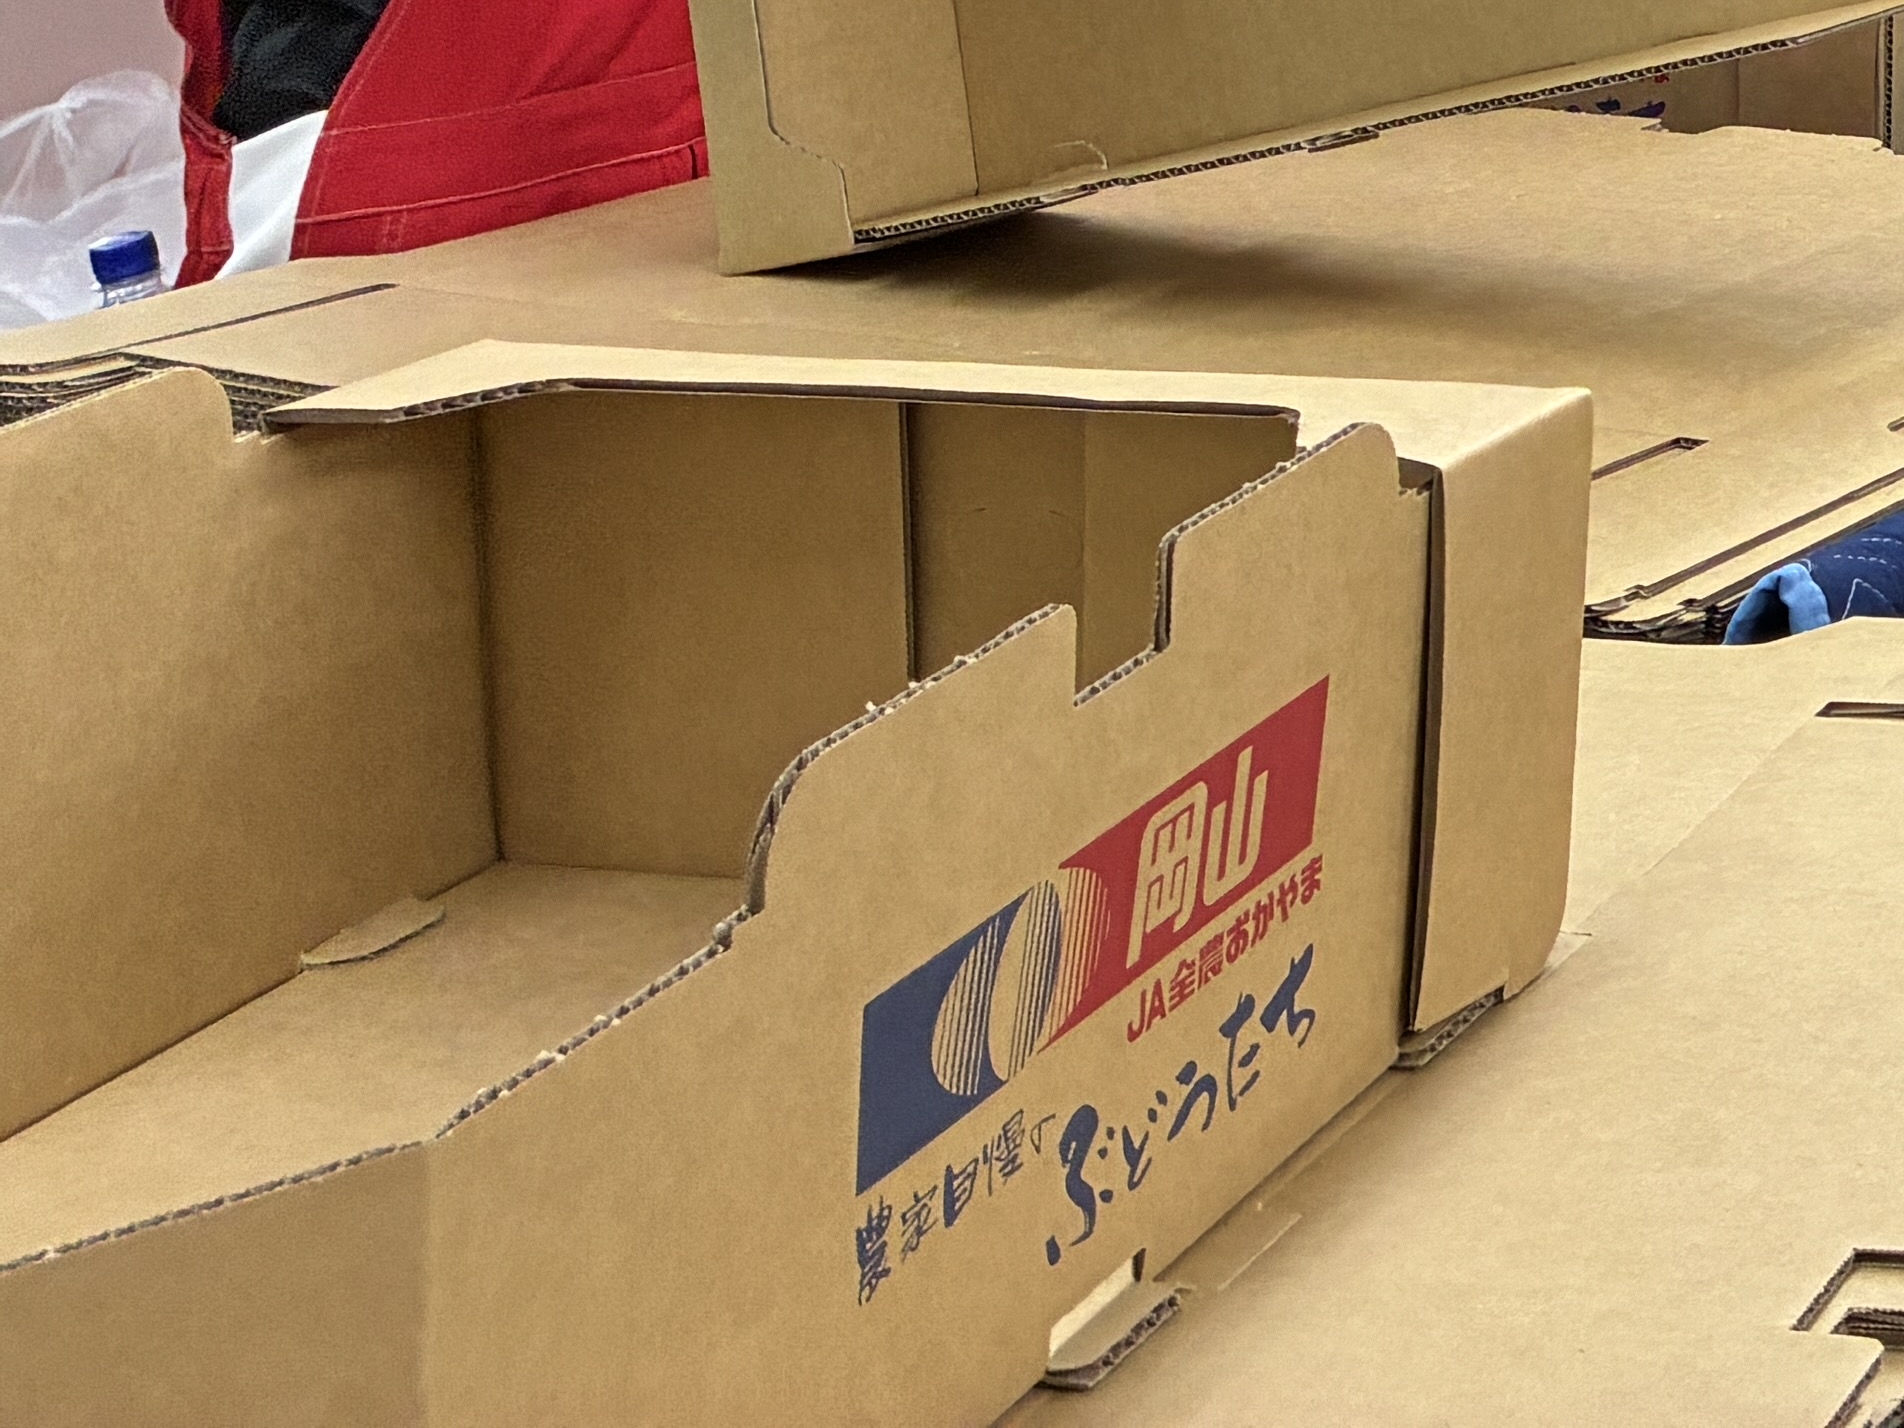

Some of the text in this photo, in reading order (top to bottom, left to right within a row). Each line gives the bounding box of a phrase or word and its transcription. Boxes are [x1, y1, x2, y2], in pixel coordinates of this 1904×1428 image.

[1126, 744, 1269, 970] 岡山
[1126, 852, 1323, 1044] JA全農おかやま
[855, 1108, 1056, 1307] 農家自慢の
[1046, 943, 1318, 1267] ぶどうたち
